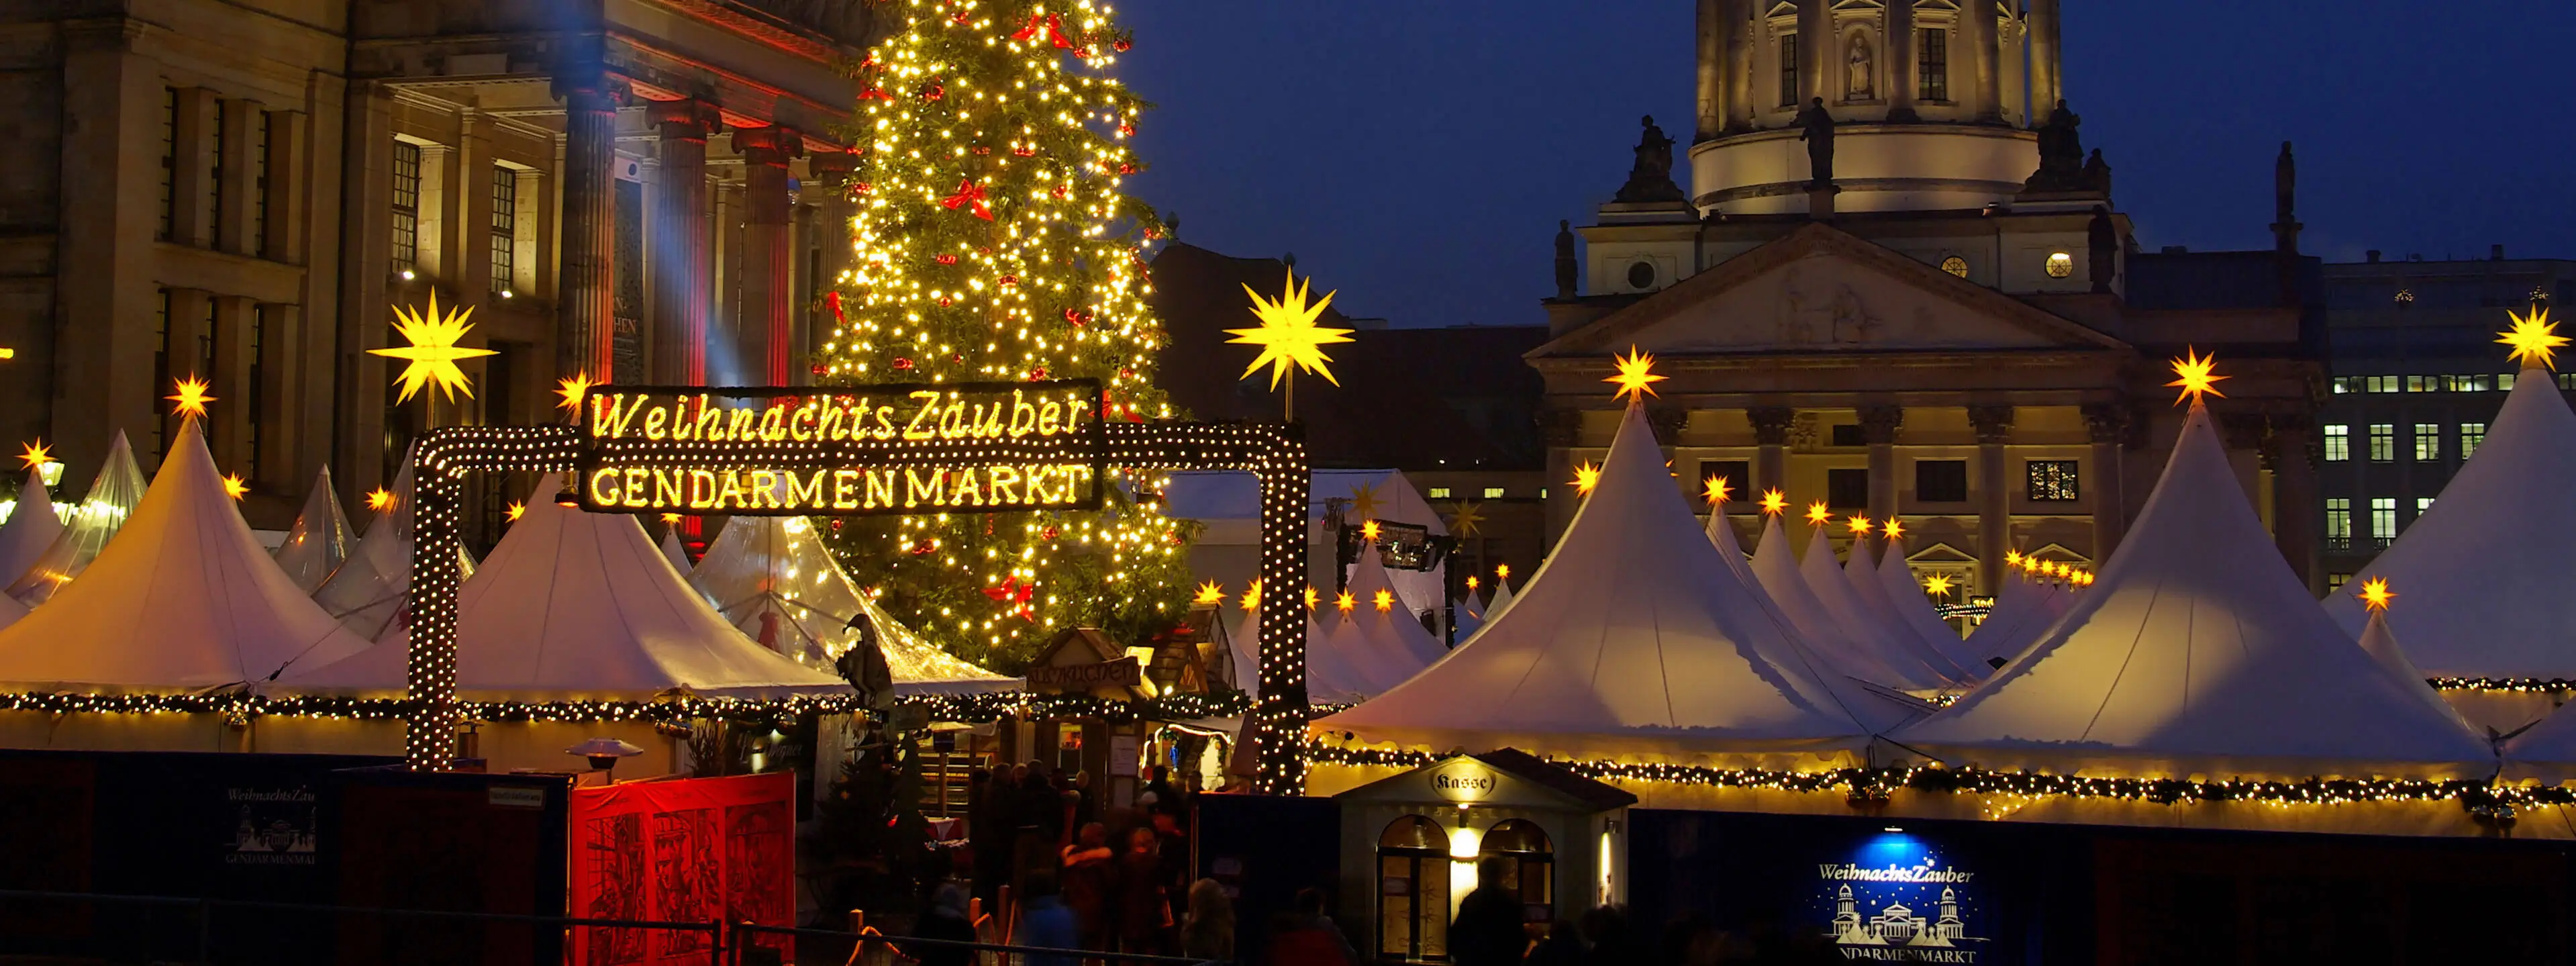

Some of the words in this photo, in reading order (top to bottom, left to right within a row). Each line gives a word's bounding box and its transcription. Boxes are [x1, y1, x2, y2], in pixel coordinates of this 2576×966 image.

[1437, 773, 1487, 789] Kasse
[1819, 863, 1975, 883] WeihnachtsZauber
[1840, 947, 1977, 963] NDARMENMARKT
